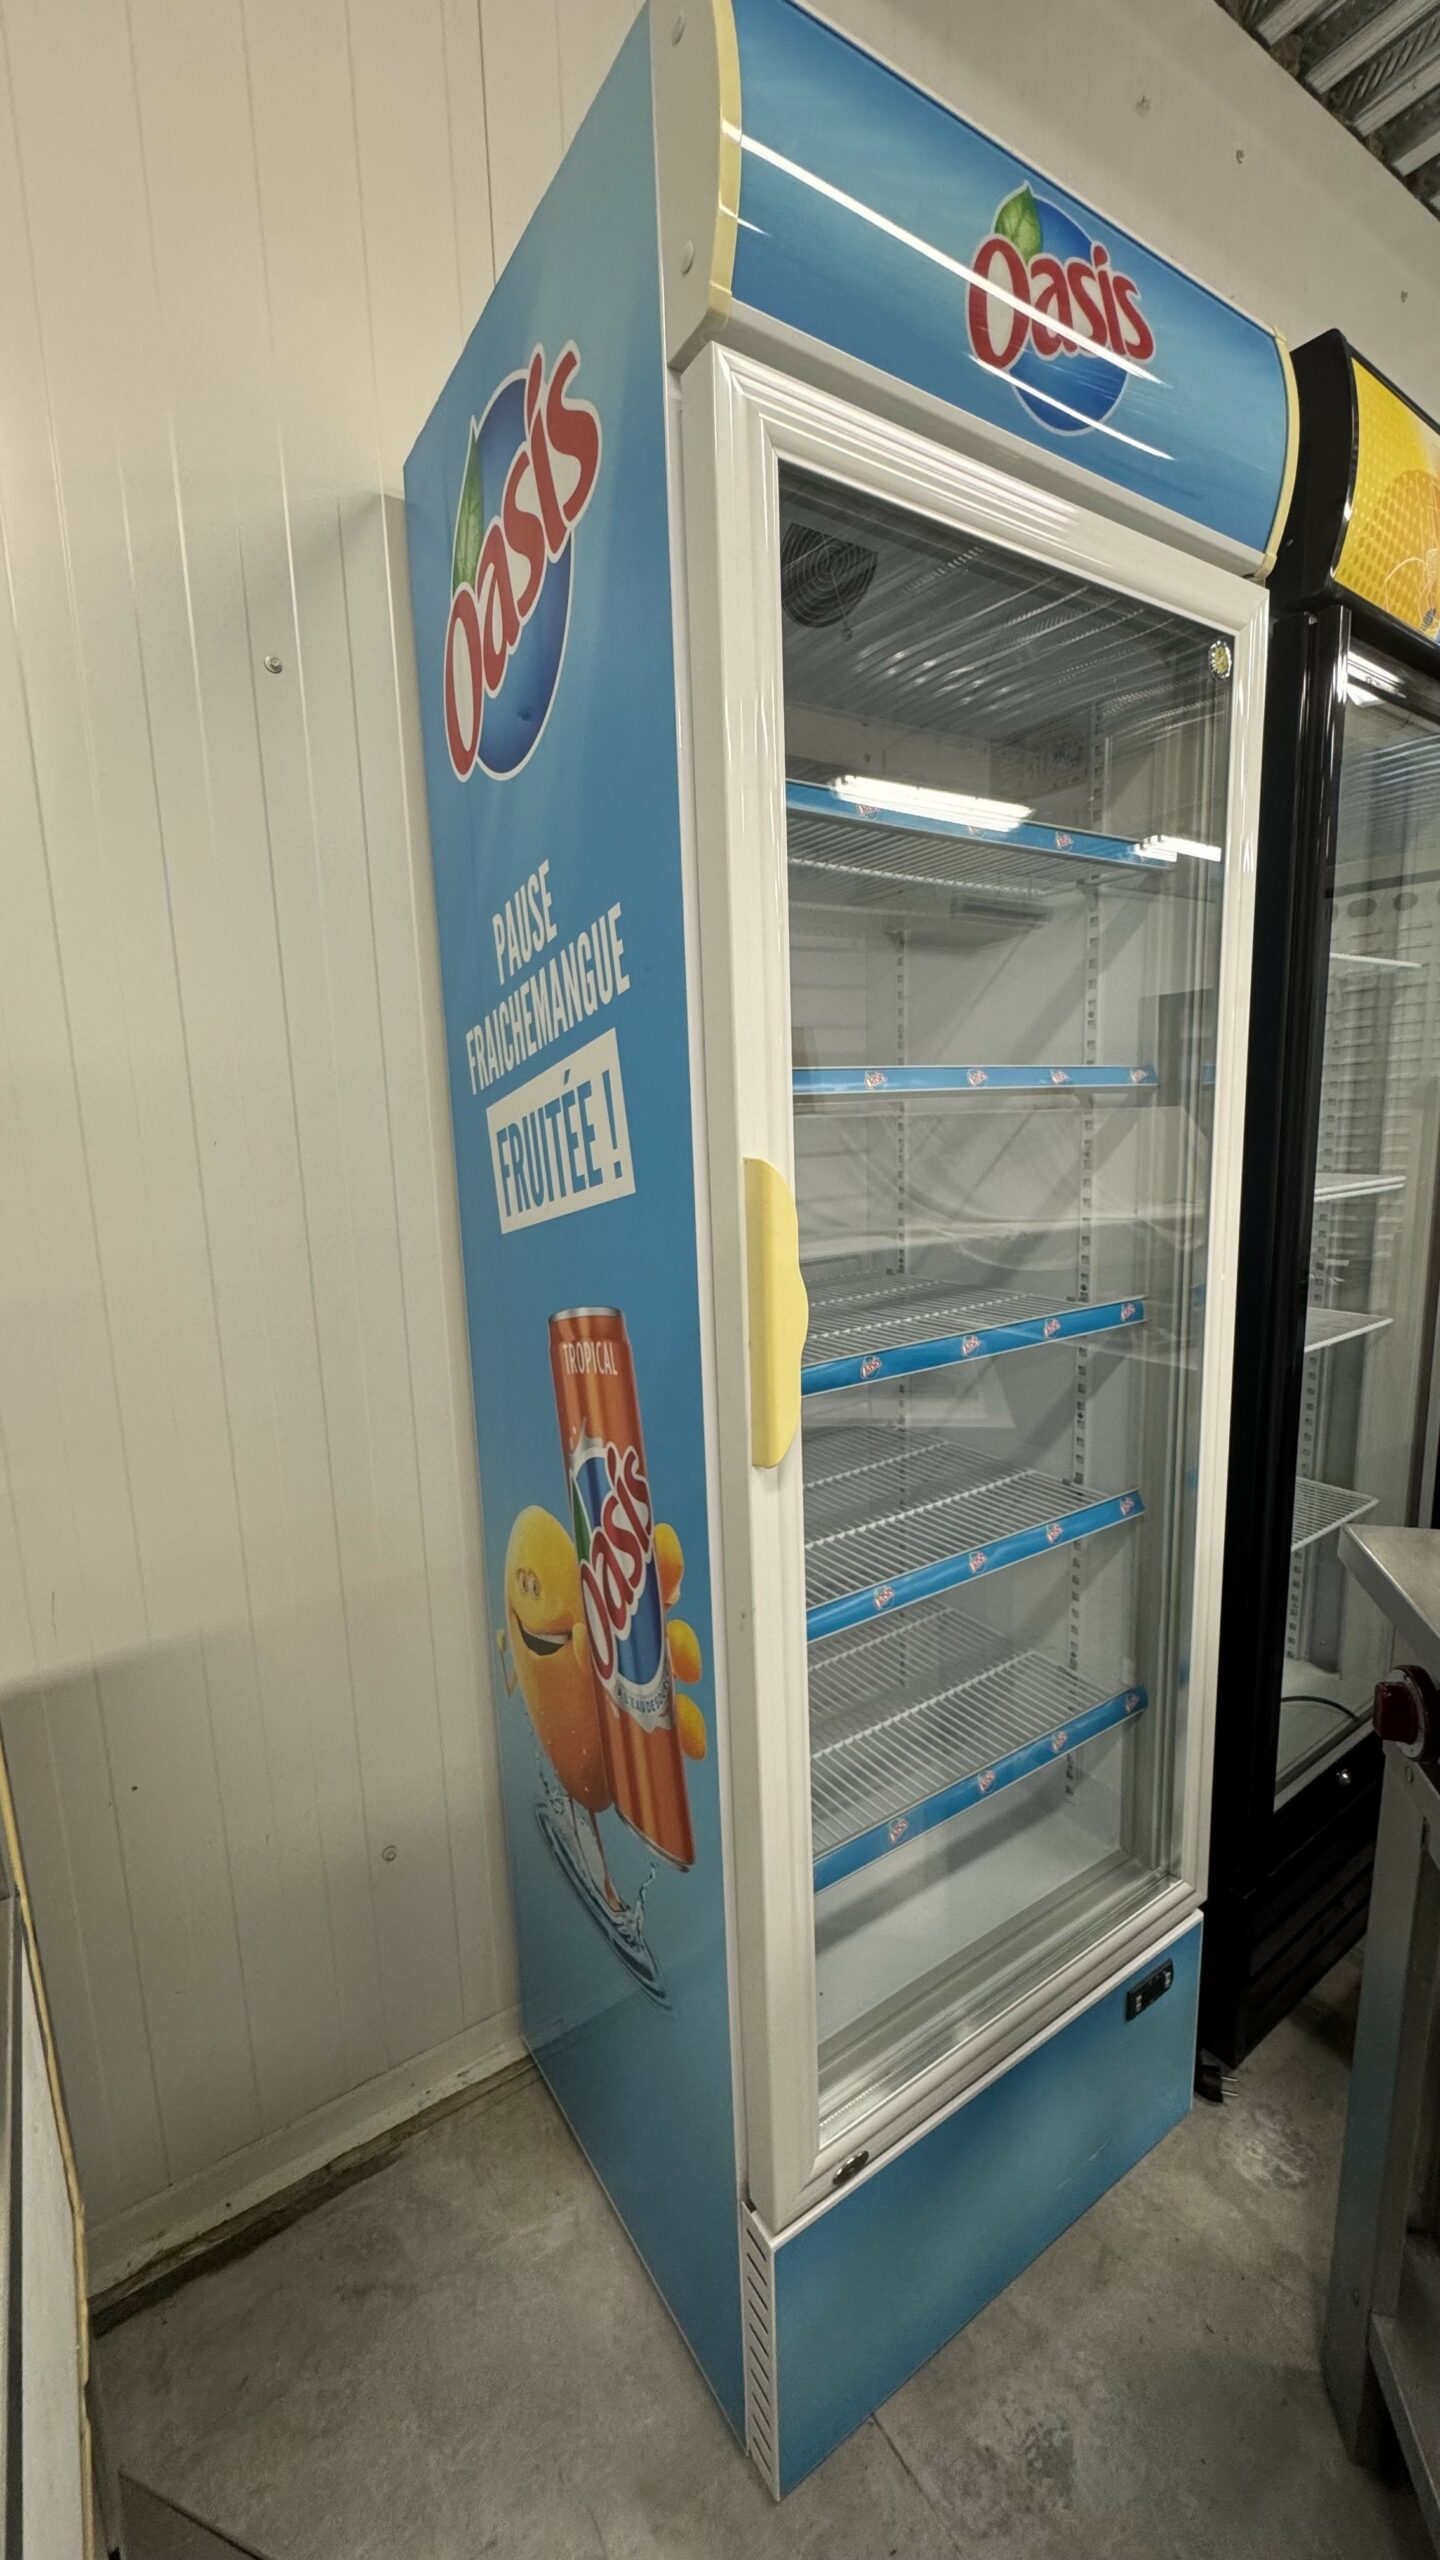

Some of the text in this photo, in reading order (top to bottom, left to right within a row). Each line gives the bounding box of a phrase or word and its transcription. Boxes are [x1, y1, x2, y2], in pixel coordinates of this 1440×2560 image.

[967, 235, 1155, 370] Oasis
[445, 345, 601, 780] Oasis
[465, 902, 630, 1096] FRAICHEMANGUE
[493, 858, 557, 985] PAUSE
[562, 1341, 618, 1376] TROPICAL
[580, 1445, 651, 1683] Oasis
